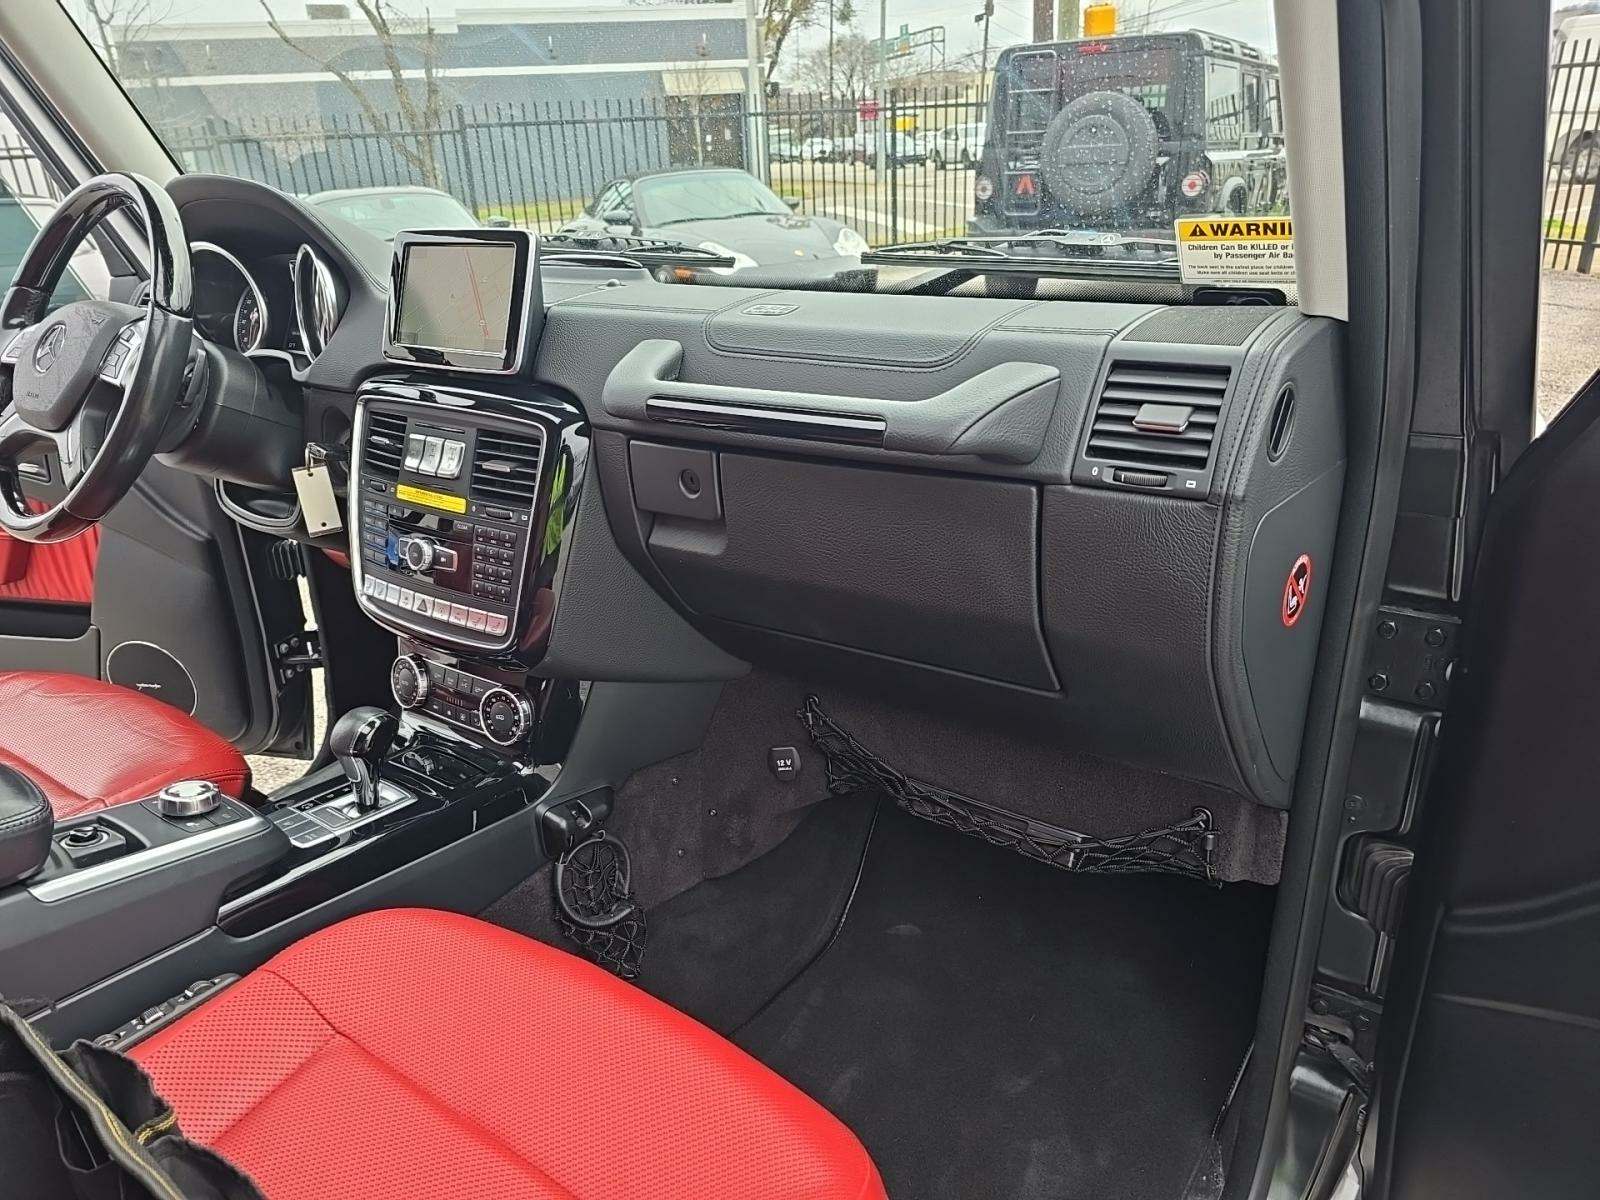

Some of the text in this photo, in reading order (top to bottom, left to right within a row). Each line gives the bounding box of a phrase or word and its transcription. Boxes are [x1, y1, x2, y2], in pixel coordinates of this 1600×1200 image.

[1209, 222, 1292, 236] WARNI
[1188, 243, 1218, 251] Children
[1225, 252, 1266, 260] Passenger
